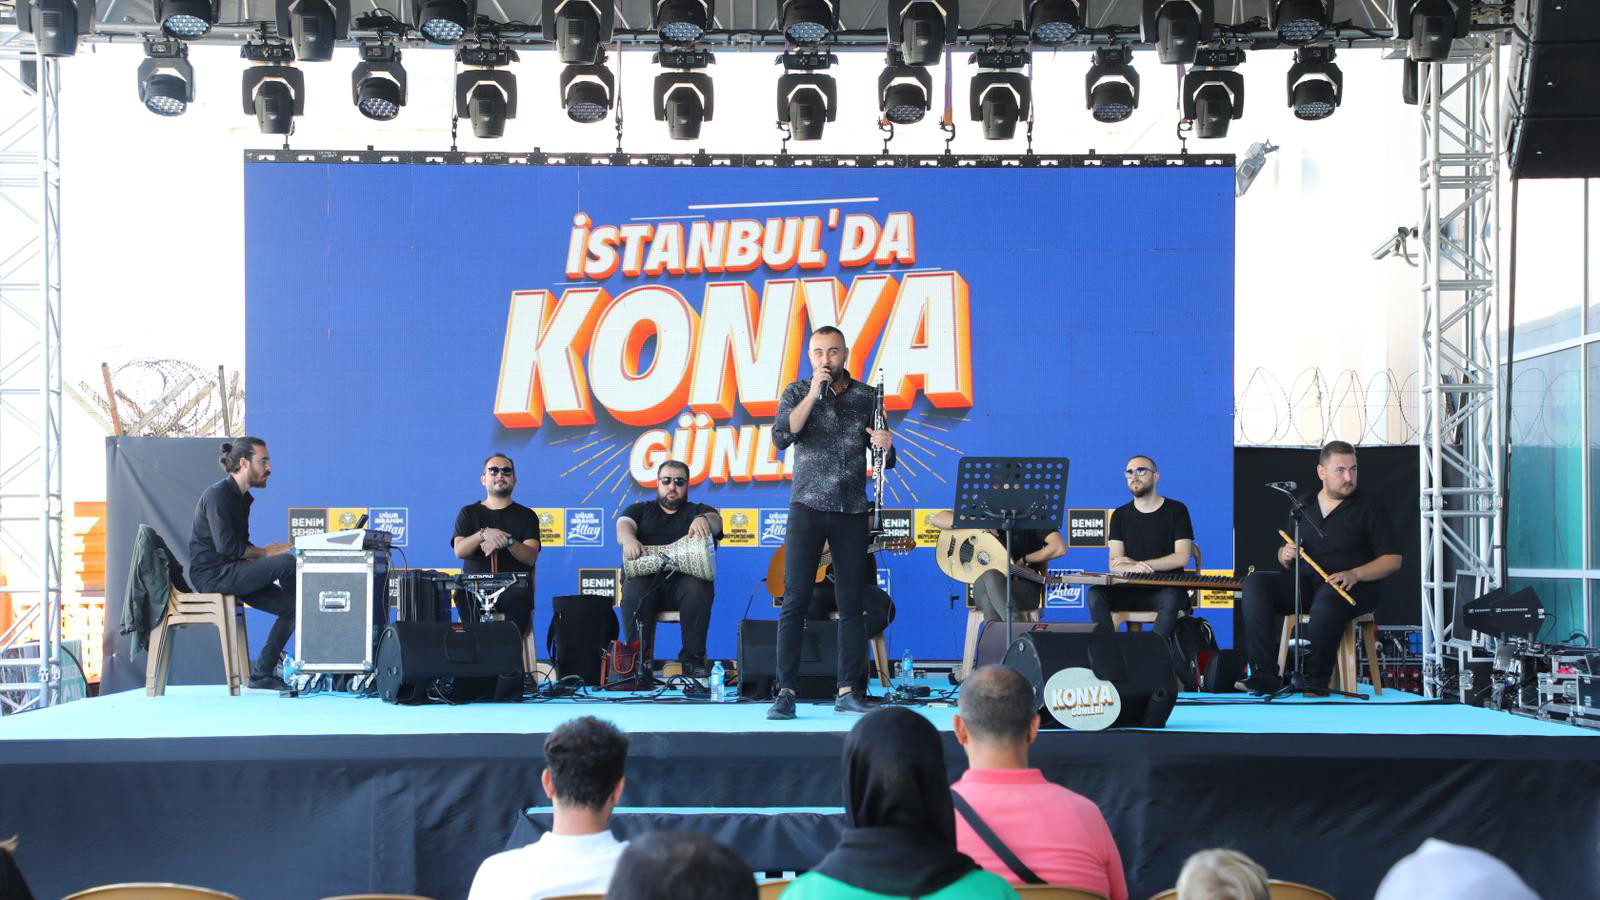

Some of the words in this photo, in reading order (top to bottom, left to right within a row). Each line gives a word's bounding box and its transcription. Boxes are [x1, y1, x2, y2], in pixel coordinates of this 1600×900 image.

[566, 207, 916, 280] İSTANBUL'DA
[493, 271, 973, 429] KONYA
[629, 411, 877, 489] GÜNL
[567, 523, 601, 541] Altay
[1051, 686, 1114, 710] KONYA
